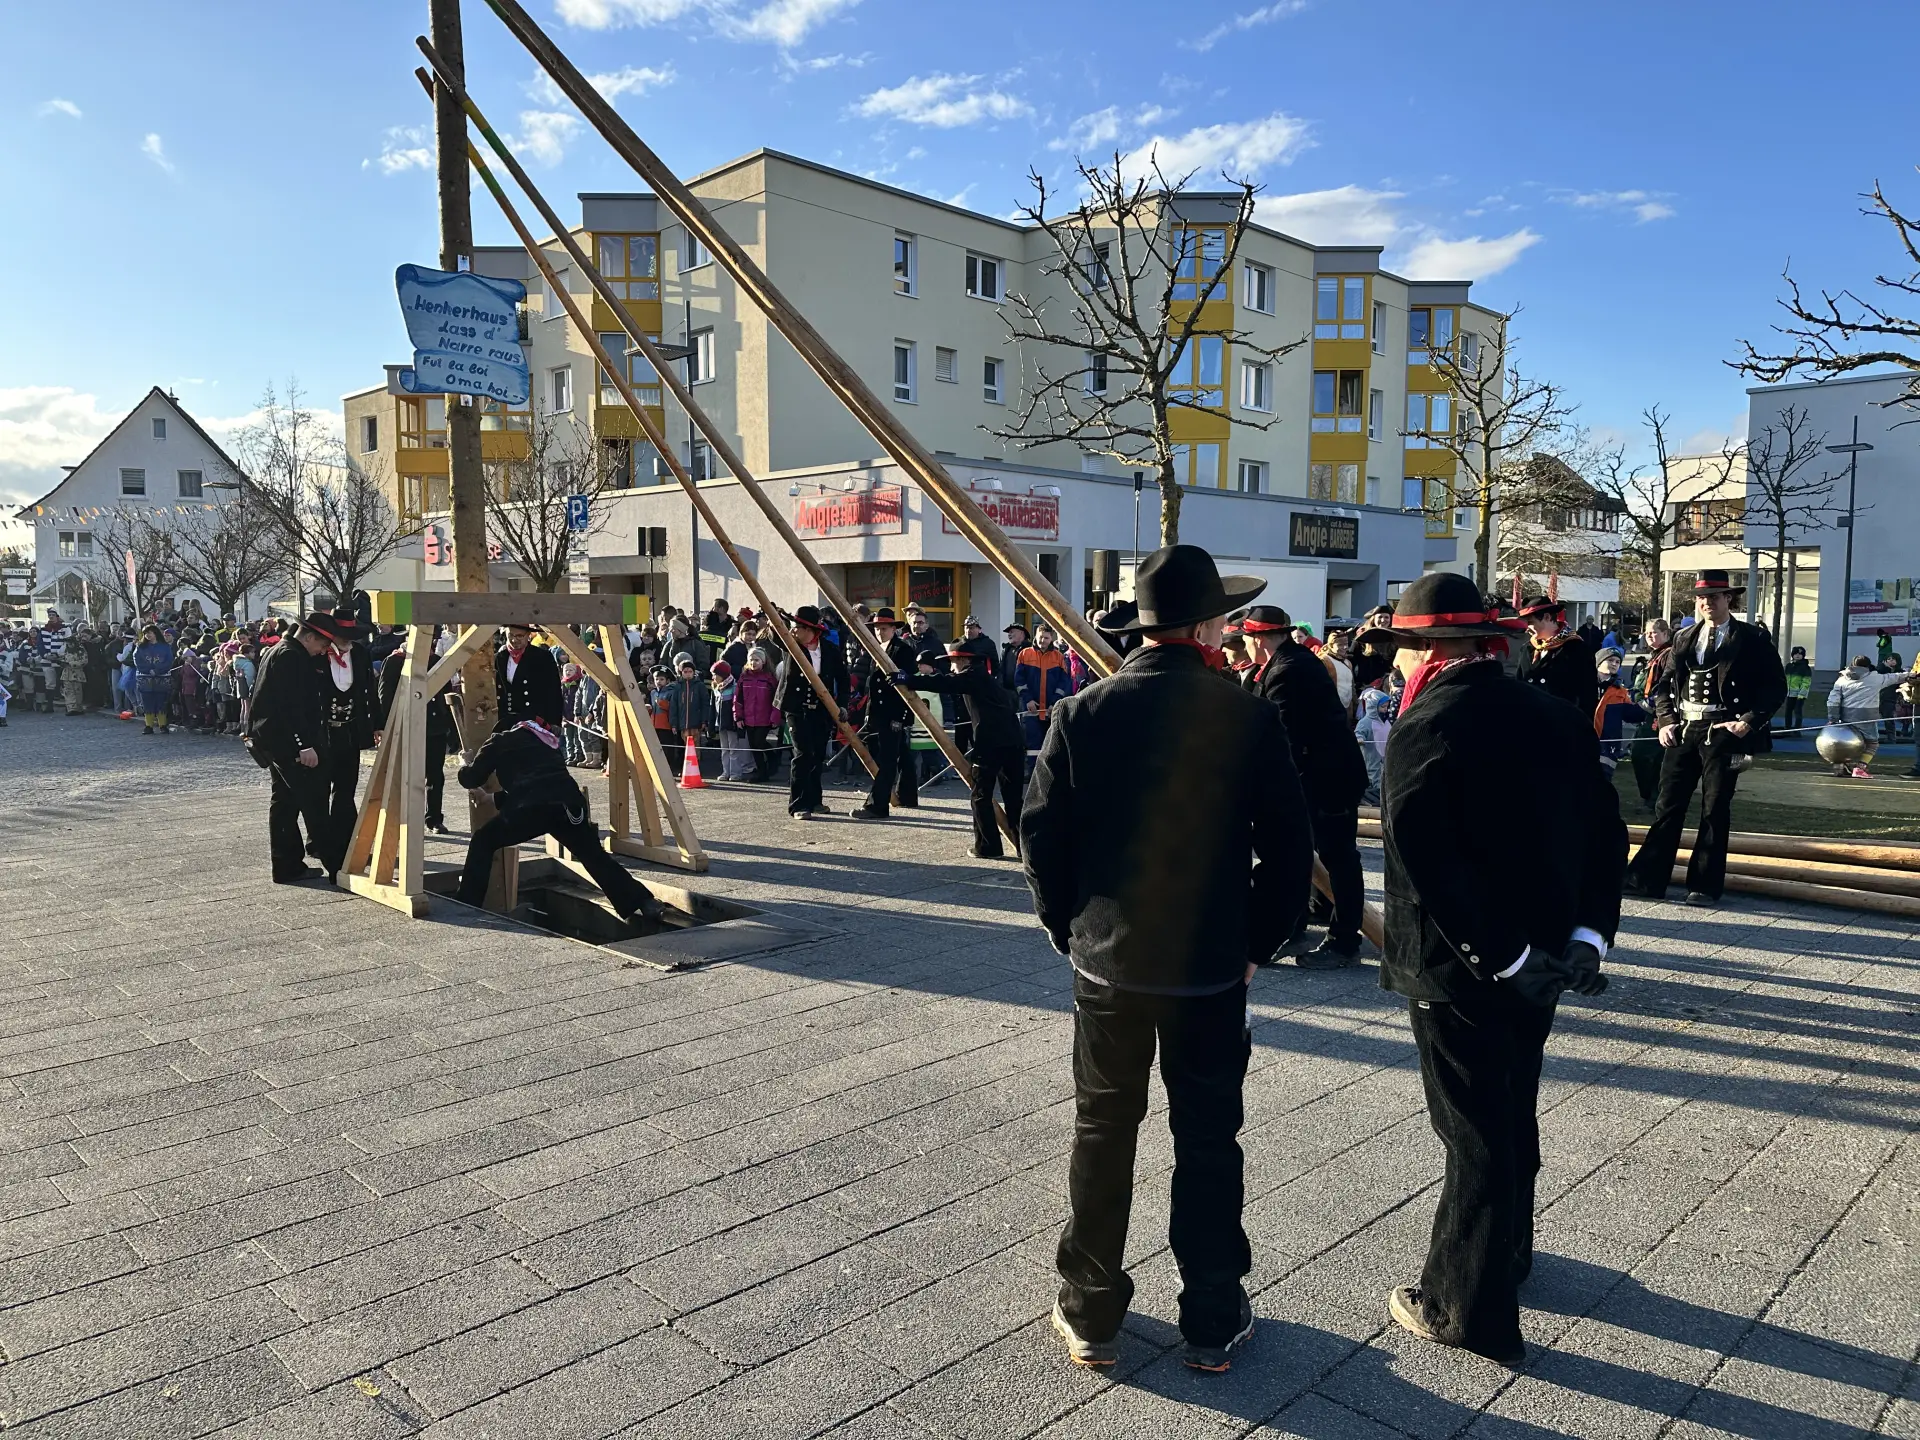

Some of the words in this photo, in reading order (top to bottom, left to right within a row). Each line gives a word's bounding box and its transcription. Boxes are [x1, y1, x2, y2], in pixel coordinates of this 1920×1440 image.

[438, 337, 483, 355] Narre
[488, 348, 521, 364] raus
[445, 375, 482, 390] Oma
[571, 500, 583, 526] P
[798, 498, 840, 536] Angie
[1000, 504, 1056, 530] HAARDESIGN
[1031, 500, 1055, 508] HERREN
[1294, 518, 1328, 555] Angie
